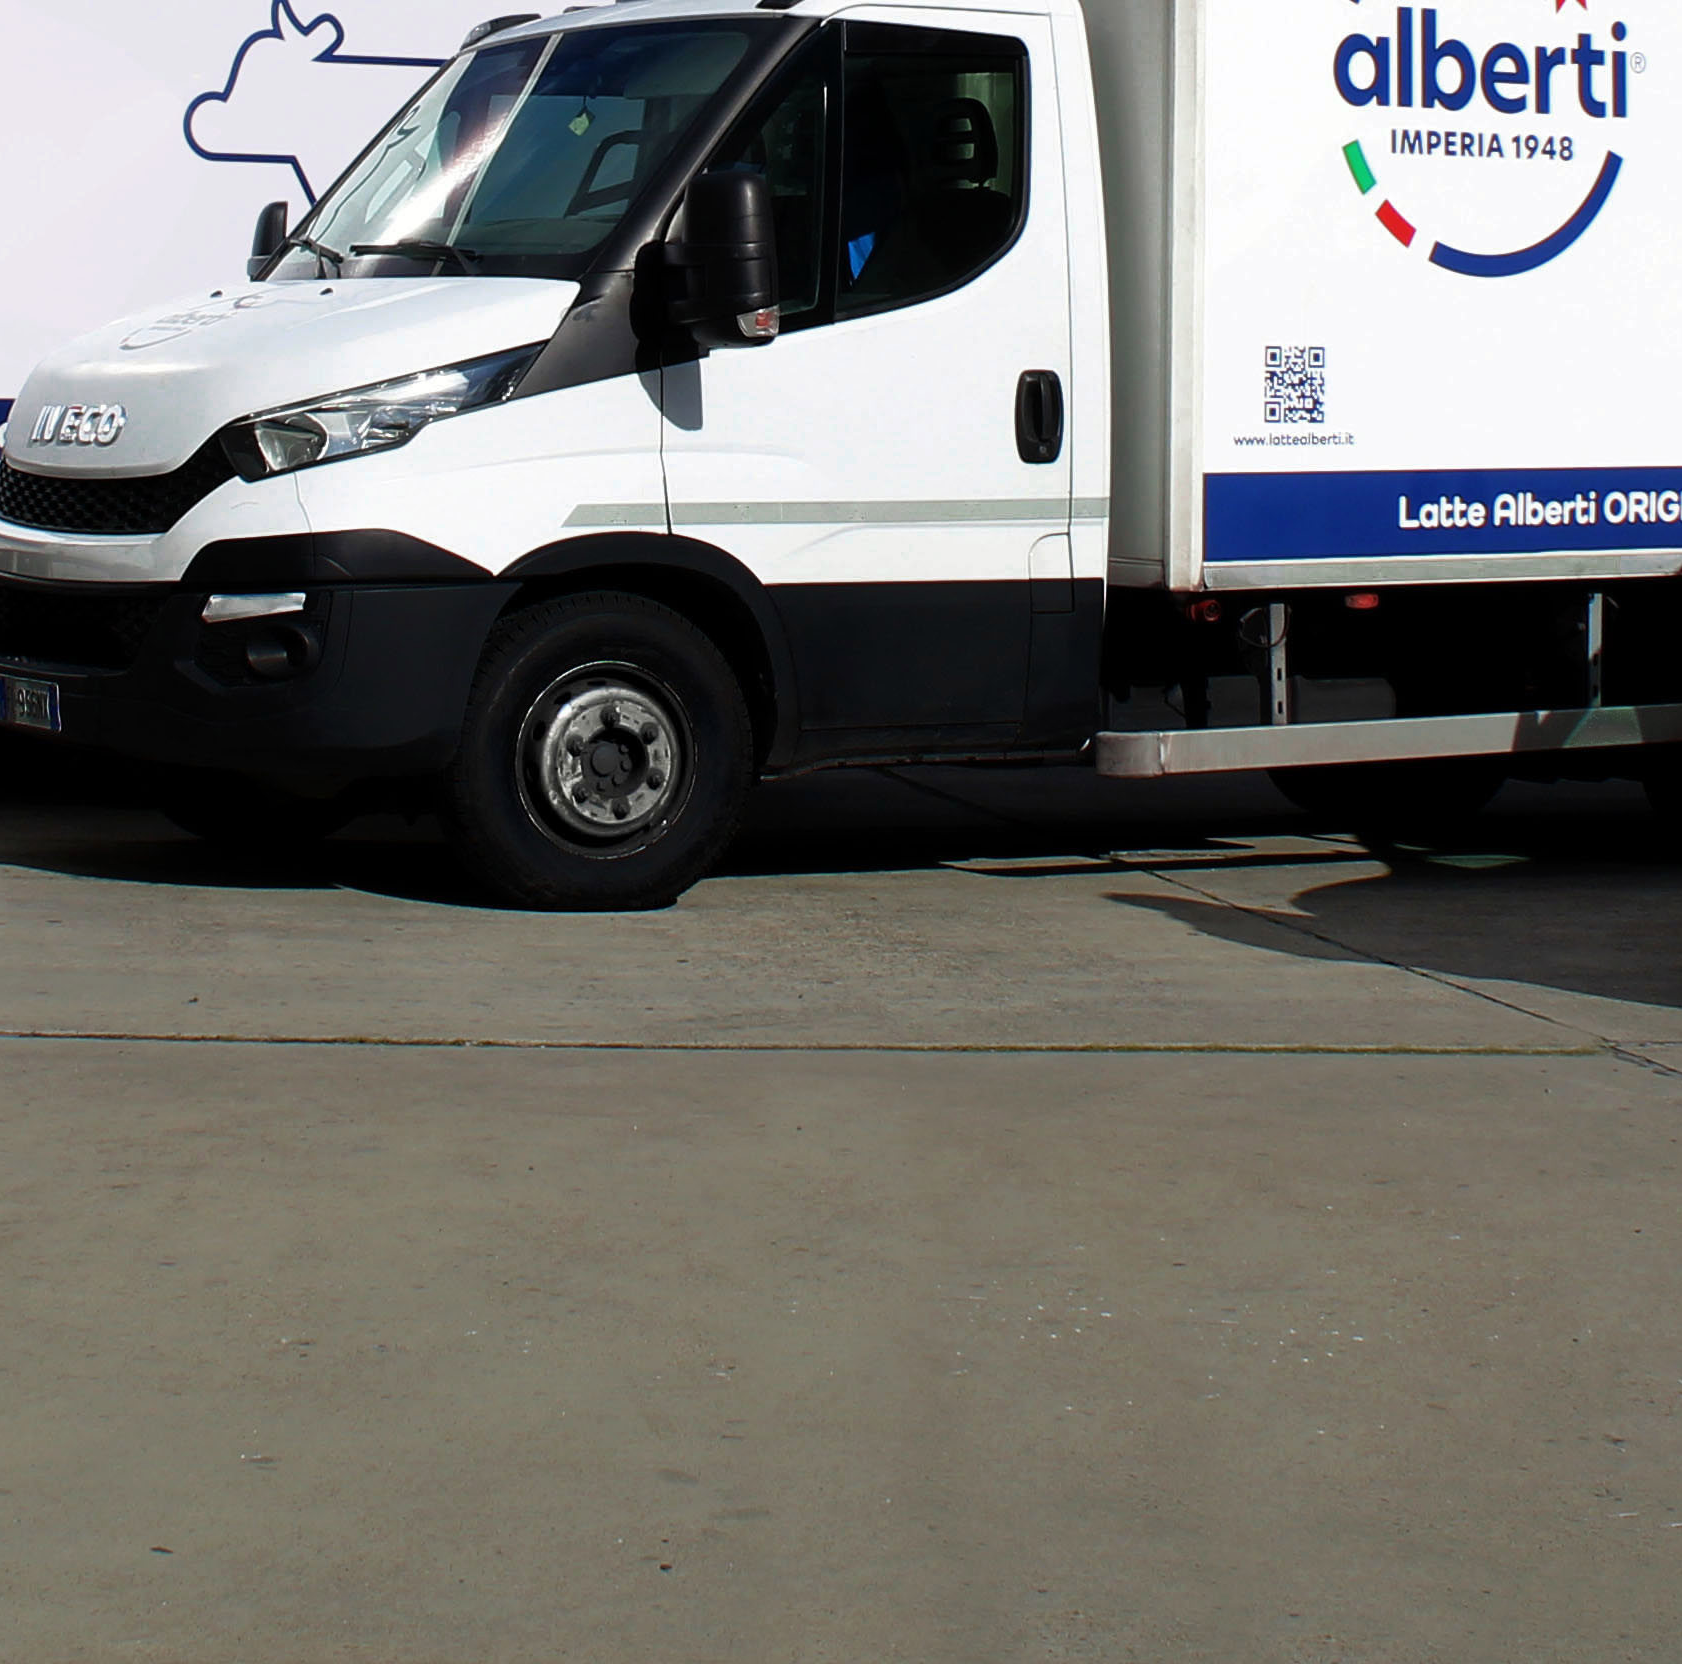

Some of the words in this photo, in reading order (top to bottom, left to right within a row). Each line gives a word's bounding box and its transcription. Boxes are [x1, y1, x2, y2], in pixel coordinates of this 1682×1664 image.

[1333, 7, 1627, 119] alberti
[1391, 129, 1504, 159] IMPERIA
[1511, 133, 1575, 162] 1948
[29, 403, 127, 444] IVECO
[1233, 431, 1355, 447] www.lattealberti.it
[1398, 494, 1486, 529] Latte
[1493, 490, 1597, 527] Alberti
